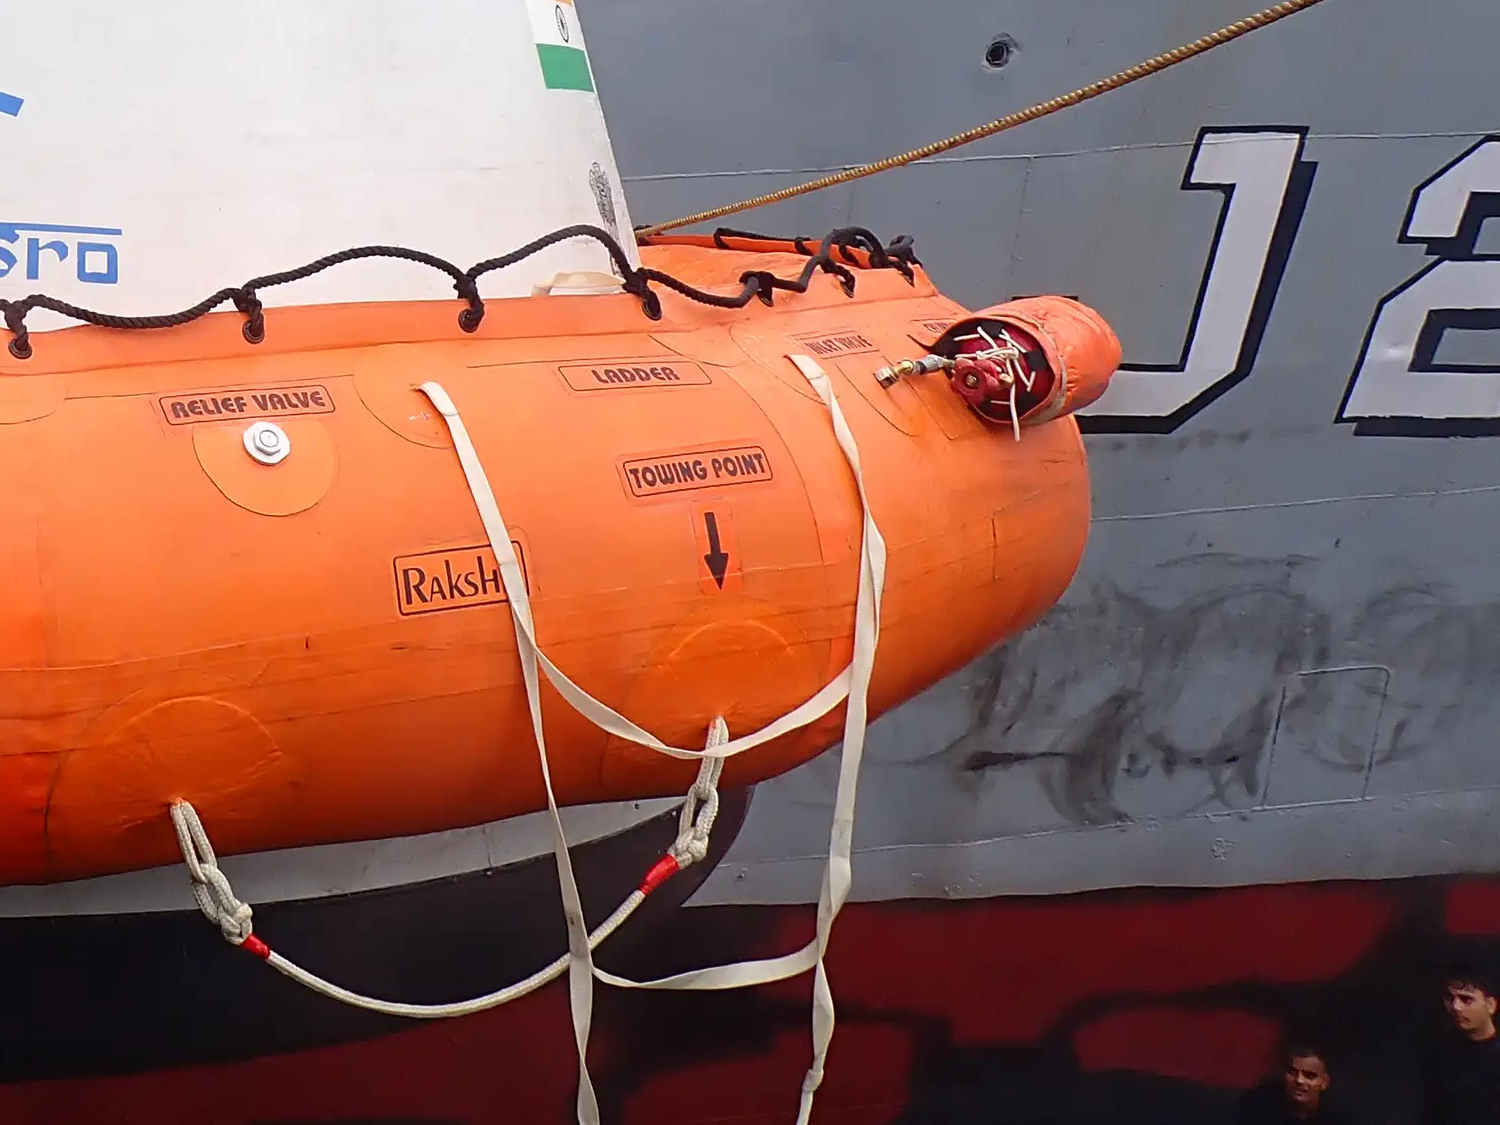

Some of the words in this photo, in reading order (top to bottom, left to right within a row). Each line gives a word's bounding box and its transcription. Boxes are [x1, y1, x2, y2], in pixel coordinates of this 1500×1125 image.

[590, 366, 681, 384] LADDER
[170, 395, 248, 419] RELIEF
[251, 390, 326, 411] VALVE
[628, 459, 708, 489] TOWING
[711, 452, 766, 479] POINT
